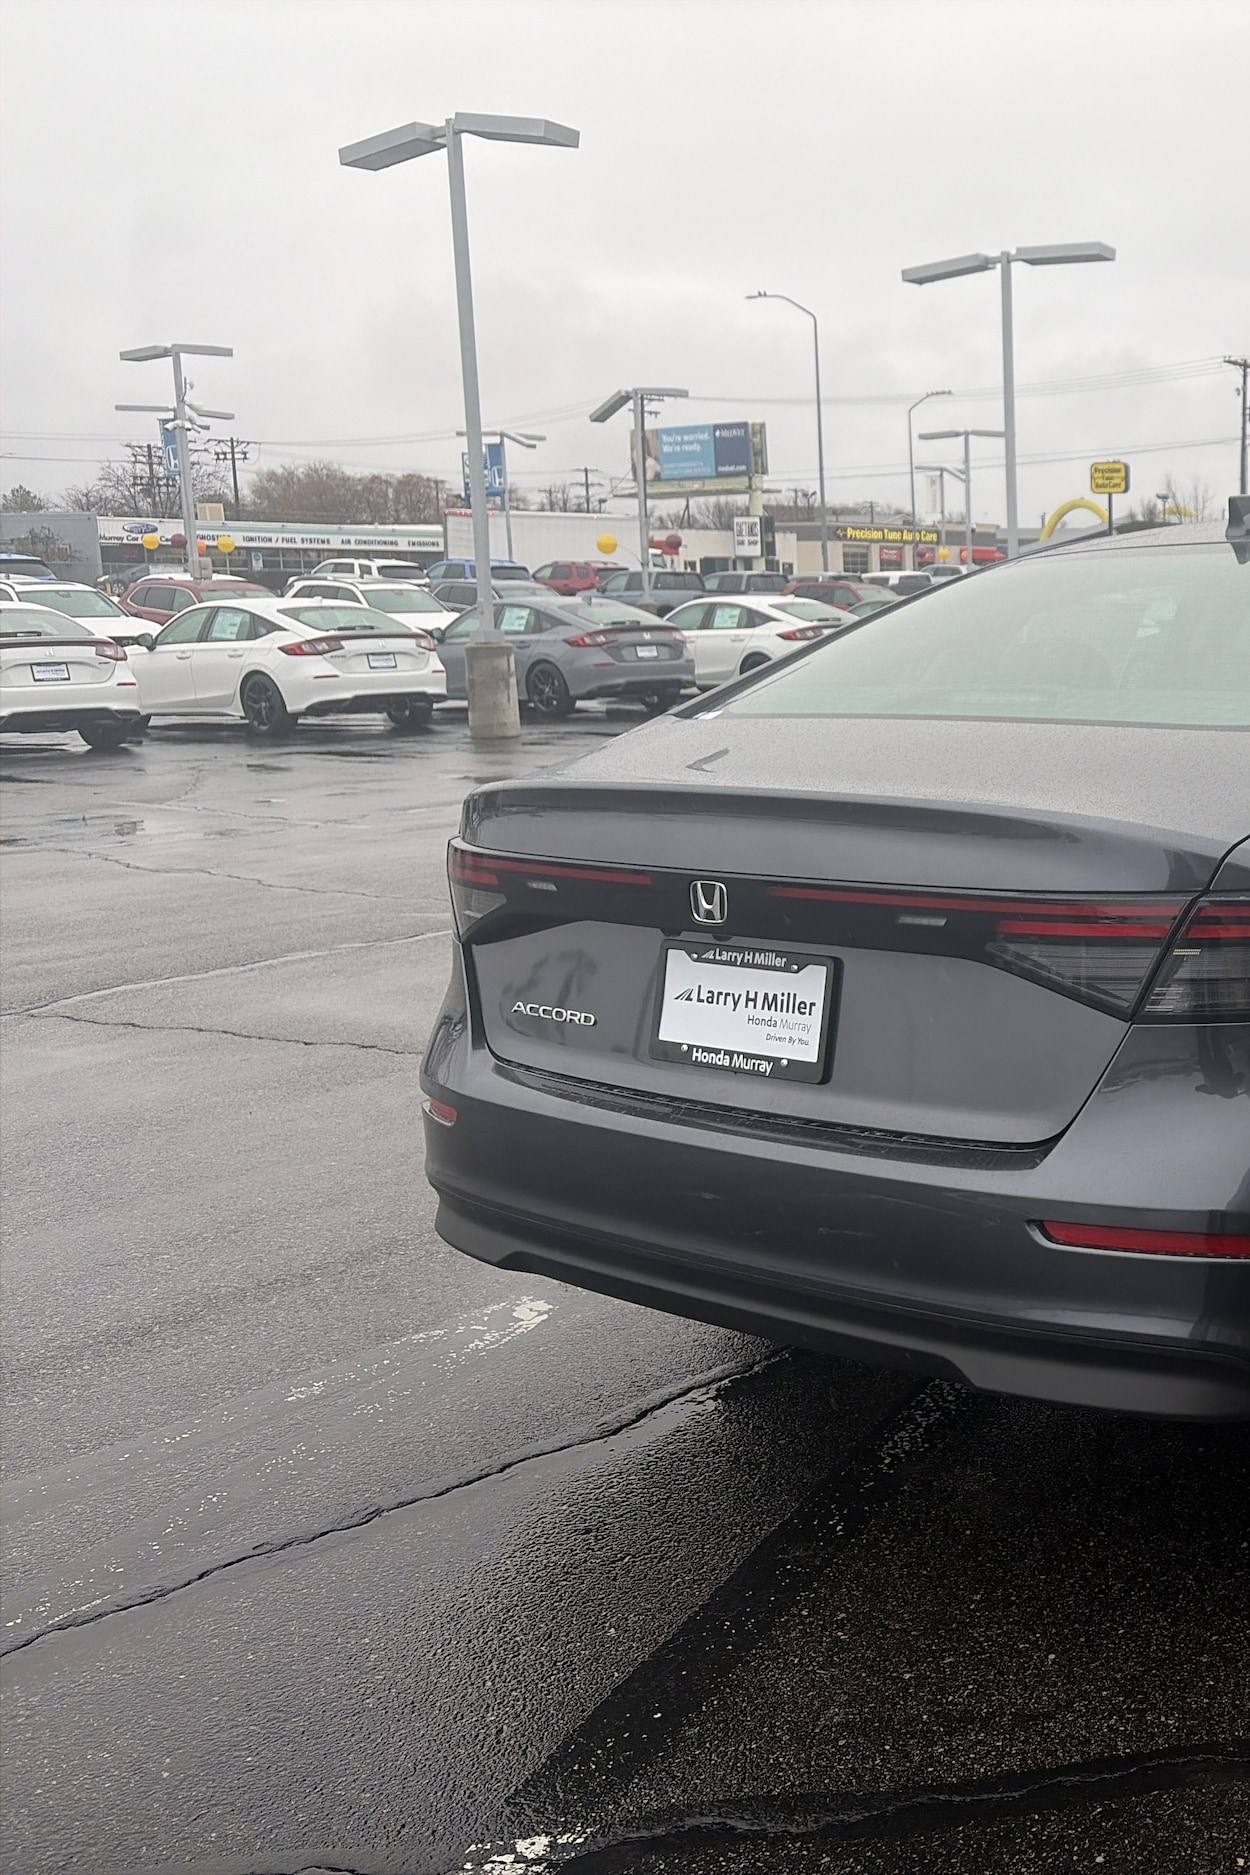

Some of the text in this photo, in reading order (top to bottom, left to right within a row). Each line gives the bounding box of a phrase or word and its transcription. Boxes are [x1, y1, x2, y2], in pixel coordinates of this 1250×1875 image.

[662, 433, 681, 442] You're
[243, 535, 273, 544] IGNITION
[281, 536, 298, 545] FUEL
[301, 537, 331, 546] SYSTEMS
[847, 527, 938, 542] Precision Tune Auo Care
[341, 538, 399, 547] AIR CONDITIONING
[407, 540, 440, 548] EMISSIONS
[715, 948, 787, 967] Larry H Miller
[696, 984, 816, 1016] Larry H Miller
[511, 1001, 598, 1026] ACCORD
[747, 1014, 812, 1035] Honda Murray
[765, 1033, 787, 1043] Driven
[788, 1035, 797, 1045] By
[692, 1048, 774, 1076] Honda Murray
